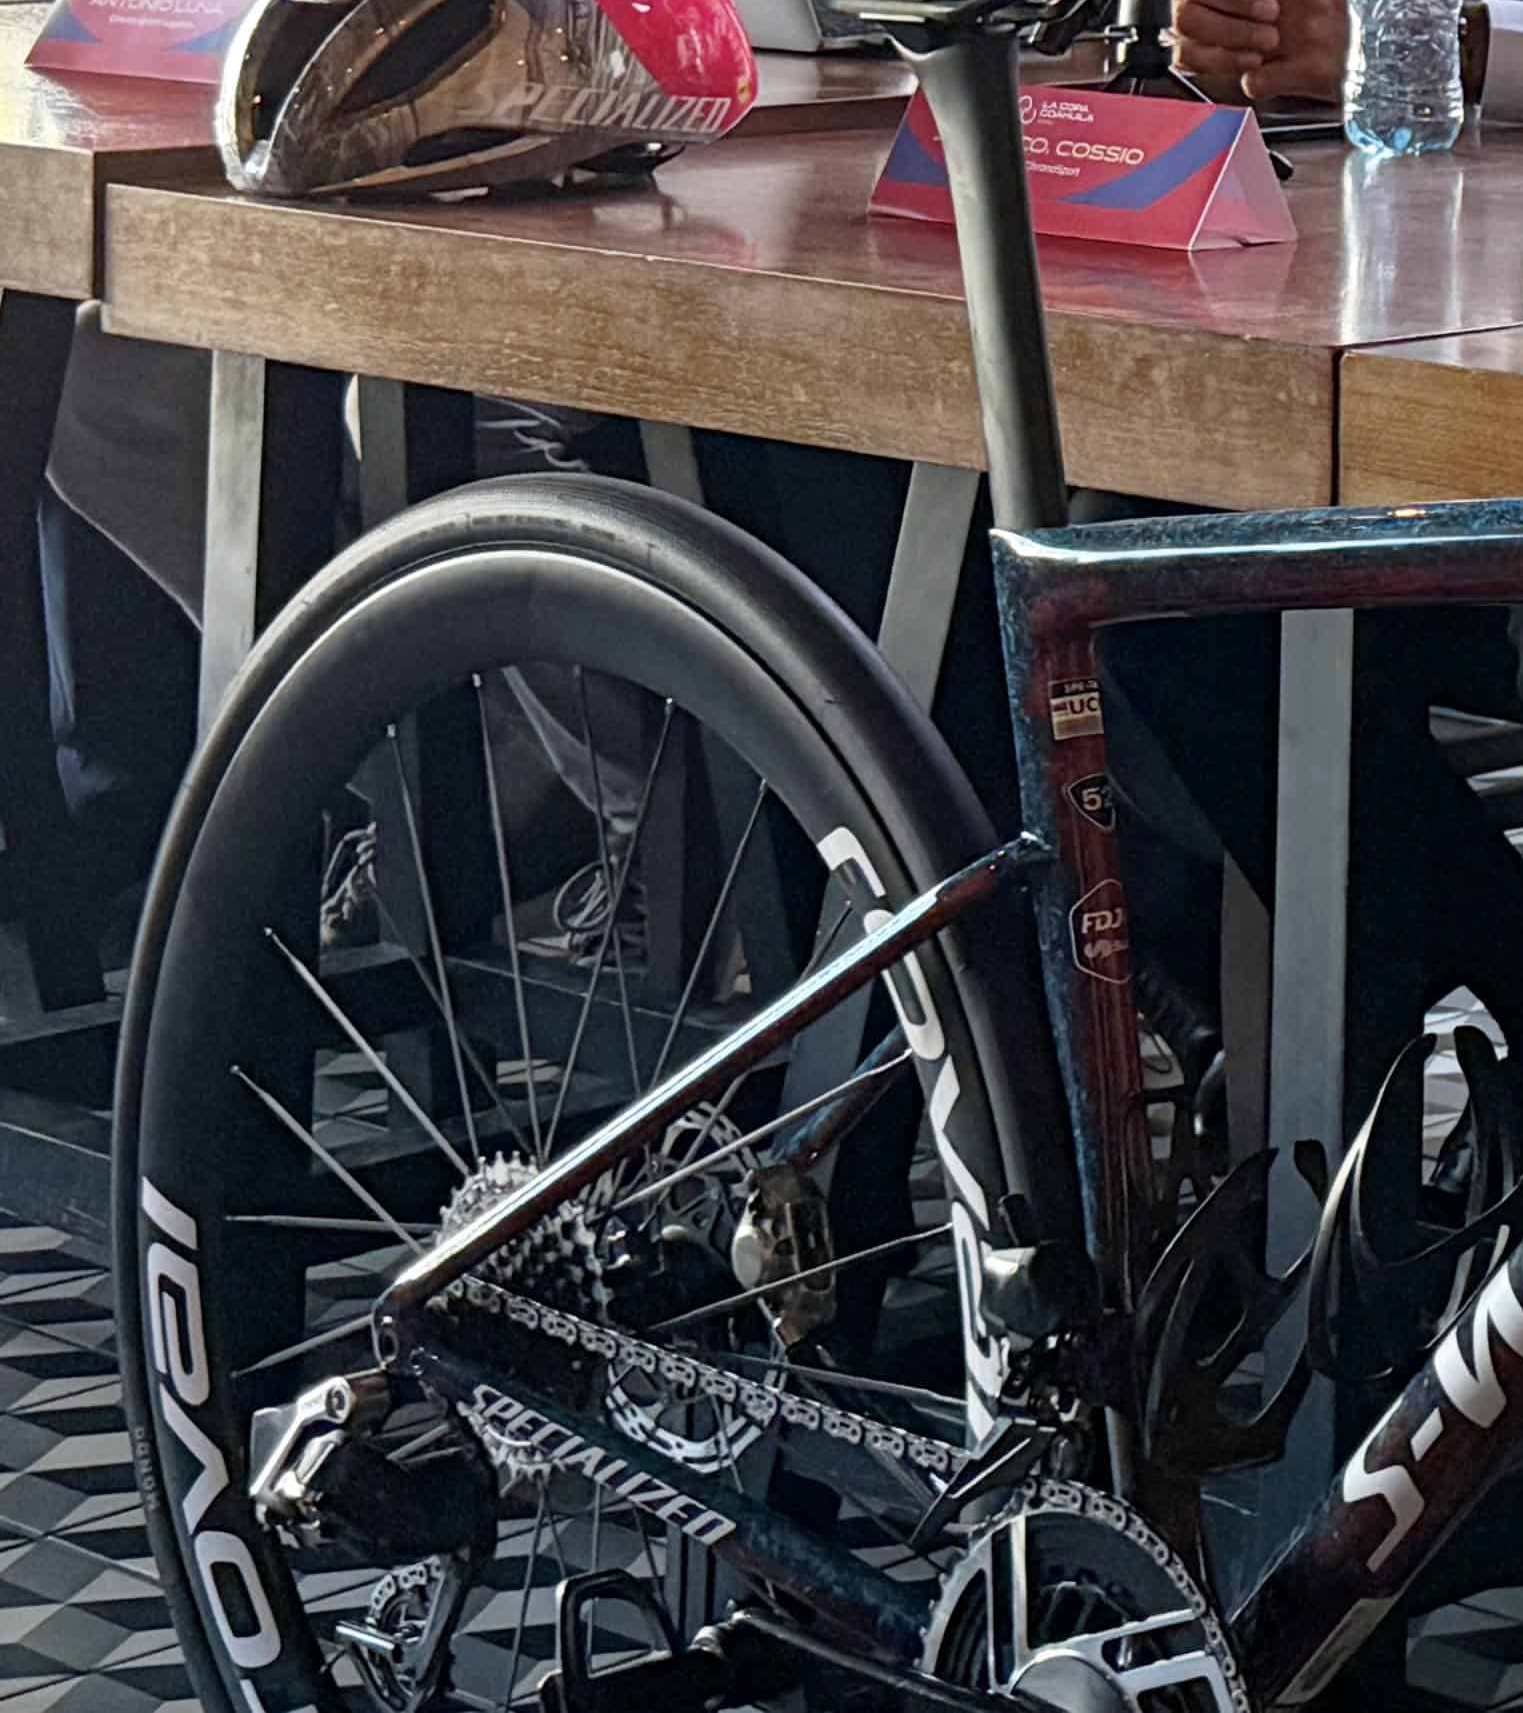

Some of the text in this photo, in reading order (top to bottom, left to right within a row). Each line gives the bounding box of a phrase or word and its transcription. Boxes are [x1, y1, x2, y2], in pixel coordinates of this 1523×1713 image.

[455, 82, 732, 134] SPECIALIZED
[1055, 140, 1145, 166] COSSIO
[473, 1383, 736, 1546] SPECIALIZED
